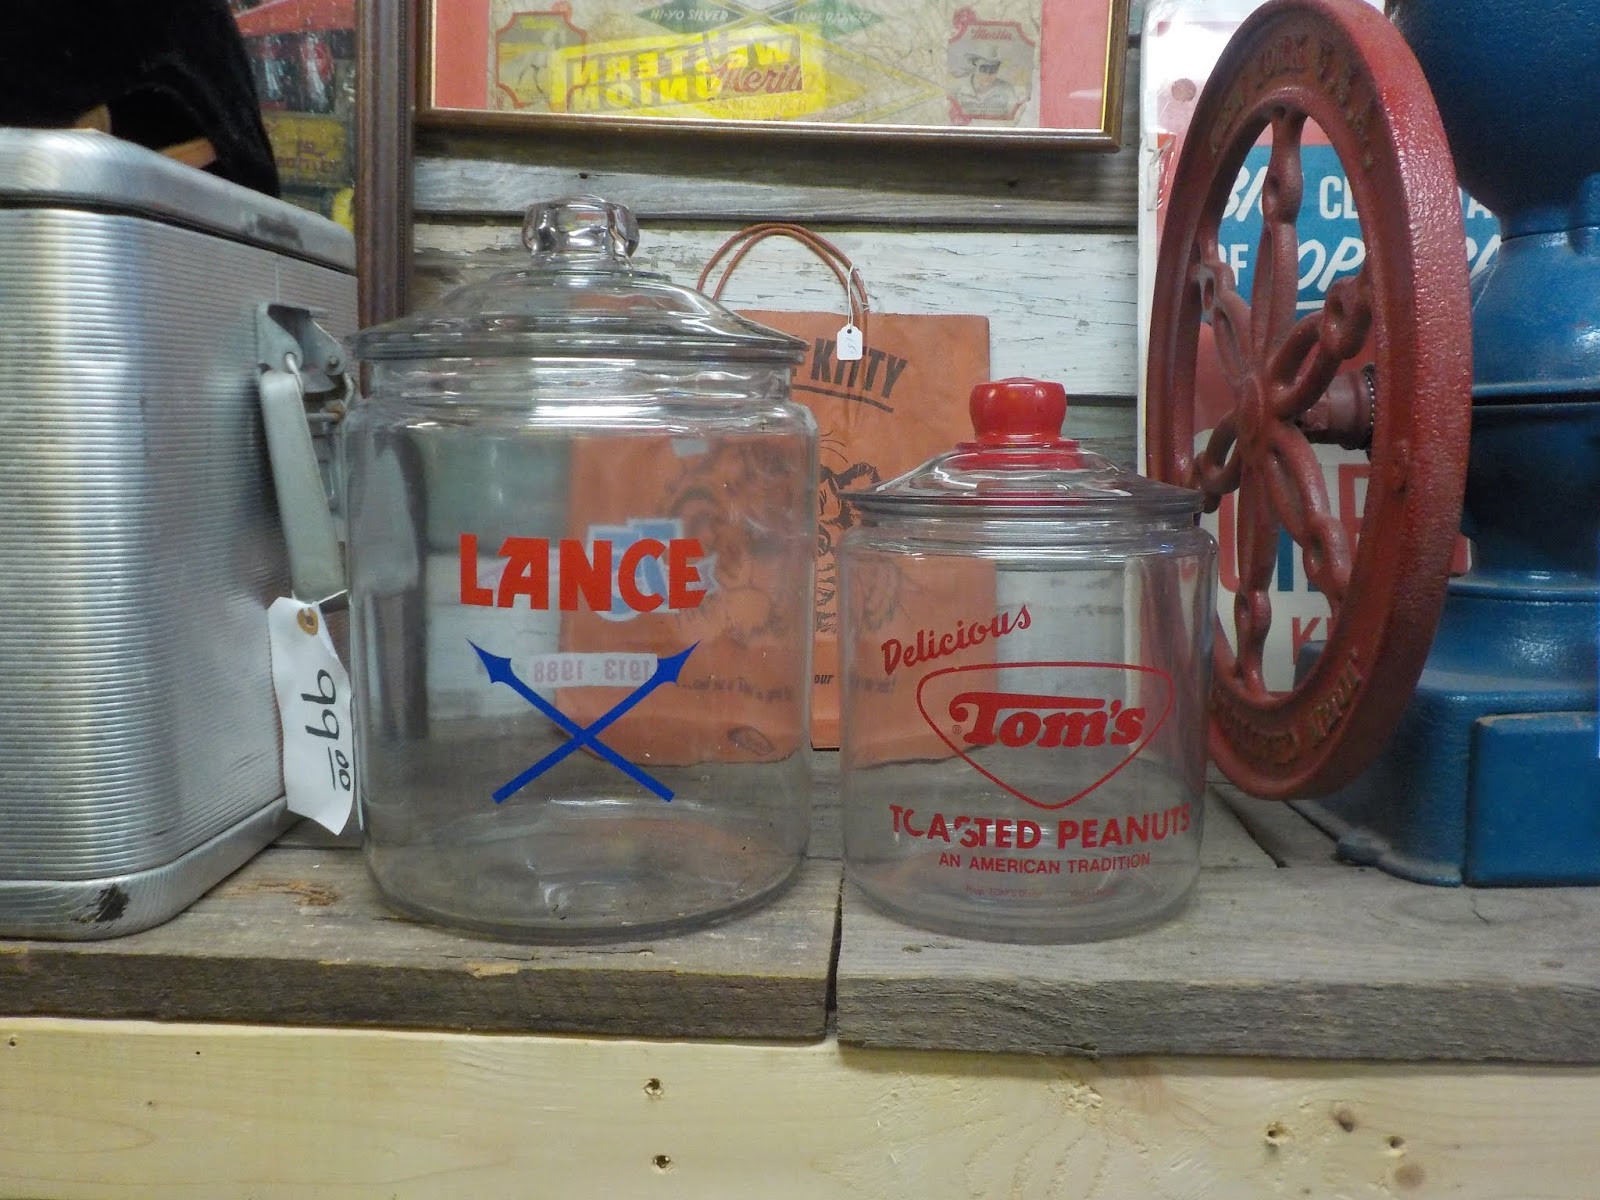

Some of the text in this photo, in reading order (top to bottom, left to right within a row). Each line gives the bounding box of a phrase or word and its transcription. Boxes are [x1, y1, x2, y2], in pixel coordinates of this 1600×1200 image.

[650, 8, 729, 22] HI-YO SILVER
[459, 533, 708, 613] LANCE
[880, 604, 1032, 675] Delicious
[949, 692, 1146, 748] Tom's
[1057, 803, 1192, 850] PEANUTS
[939, 852, 1151, 875] AN AMERICAN TRADITION
